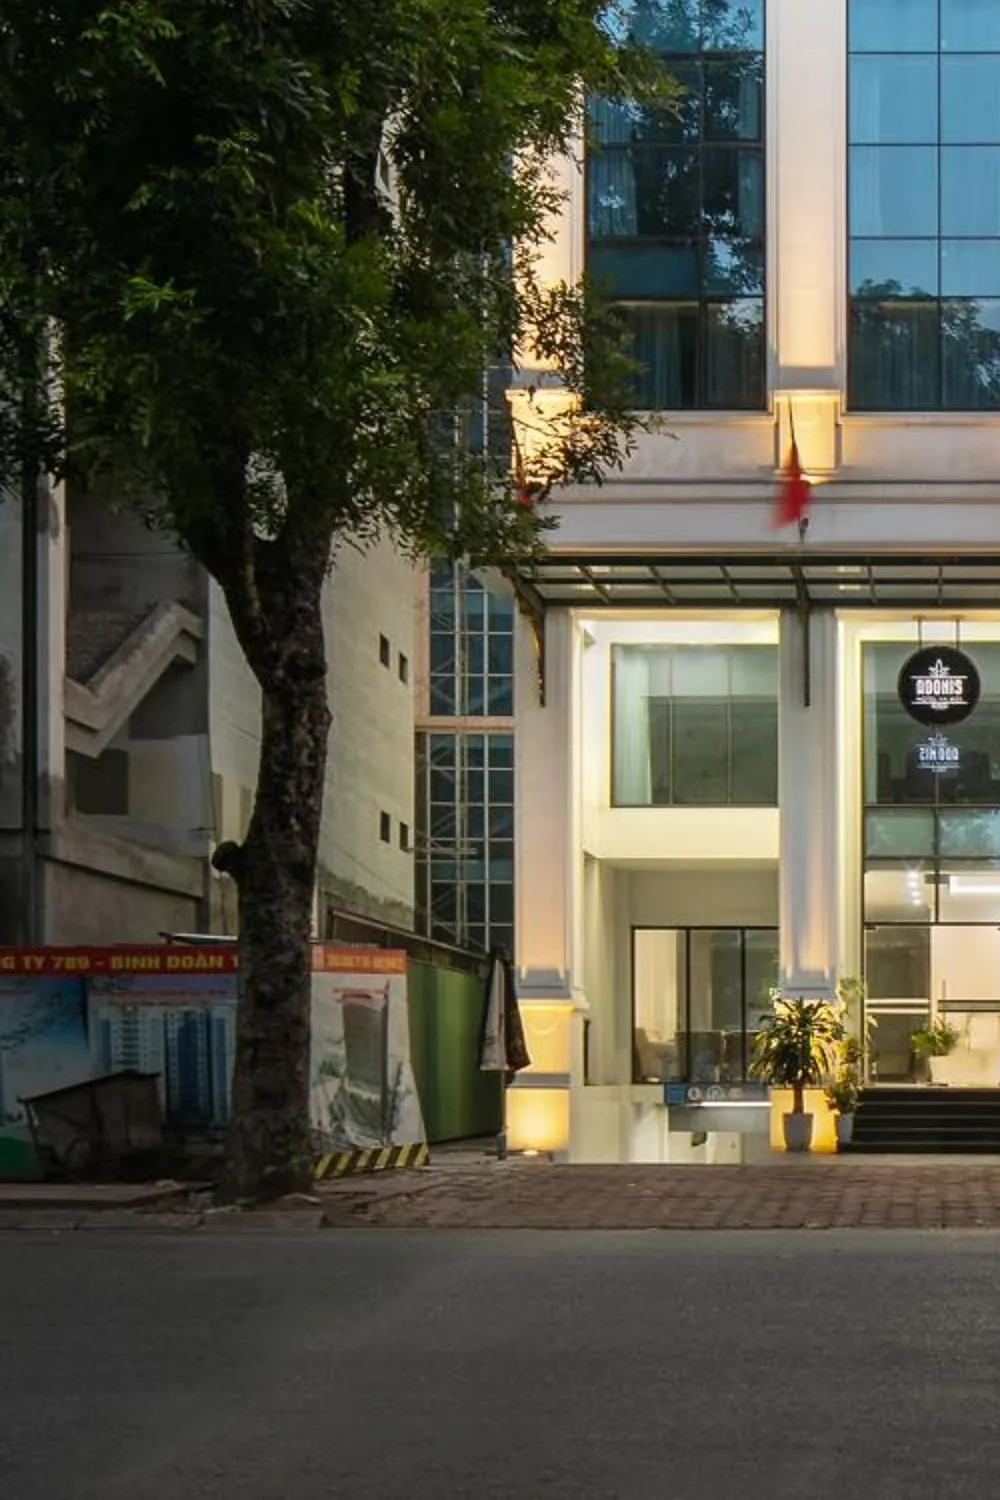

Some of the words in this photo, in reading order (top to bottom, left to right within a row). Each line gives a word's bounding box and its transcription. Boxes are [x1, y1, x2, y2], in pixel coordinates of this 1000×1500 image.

[915, 679, 963, 695] ADONIS
[23, 955, 45, 970] TY
[110, 954, 160, 970] BINH
